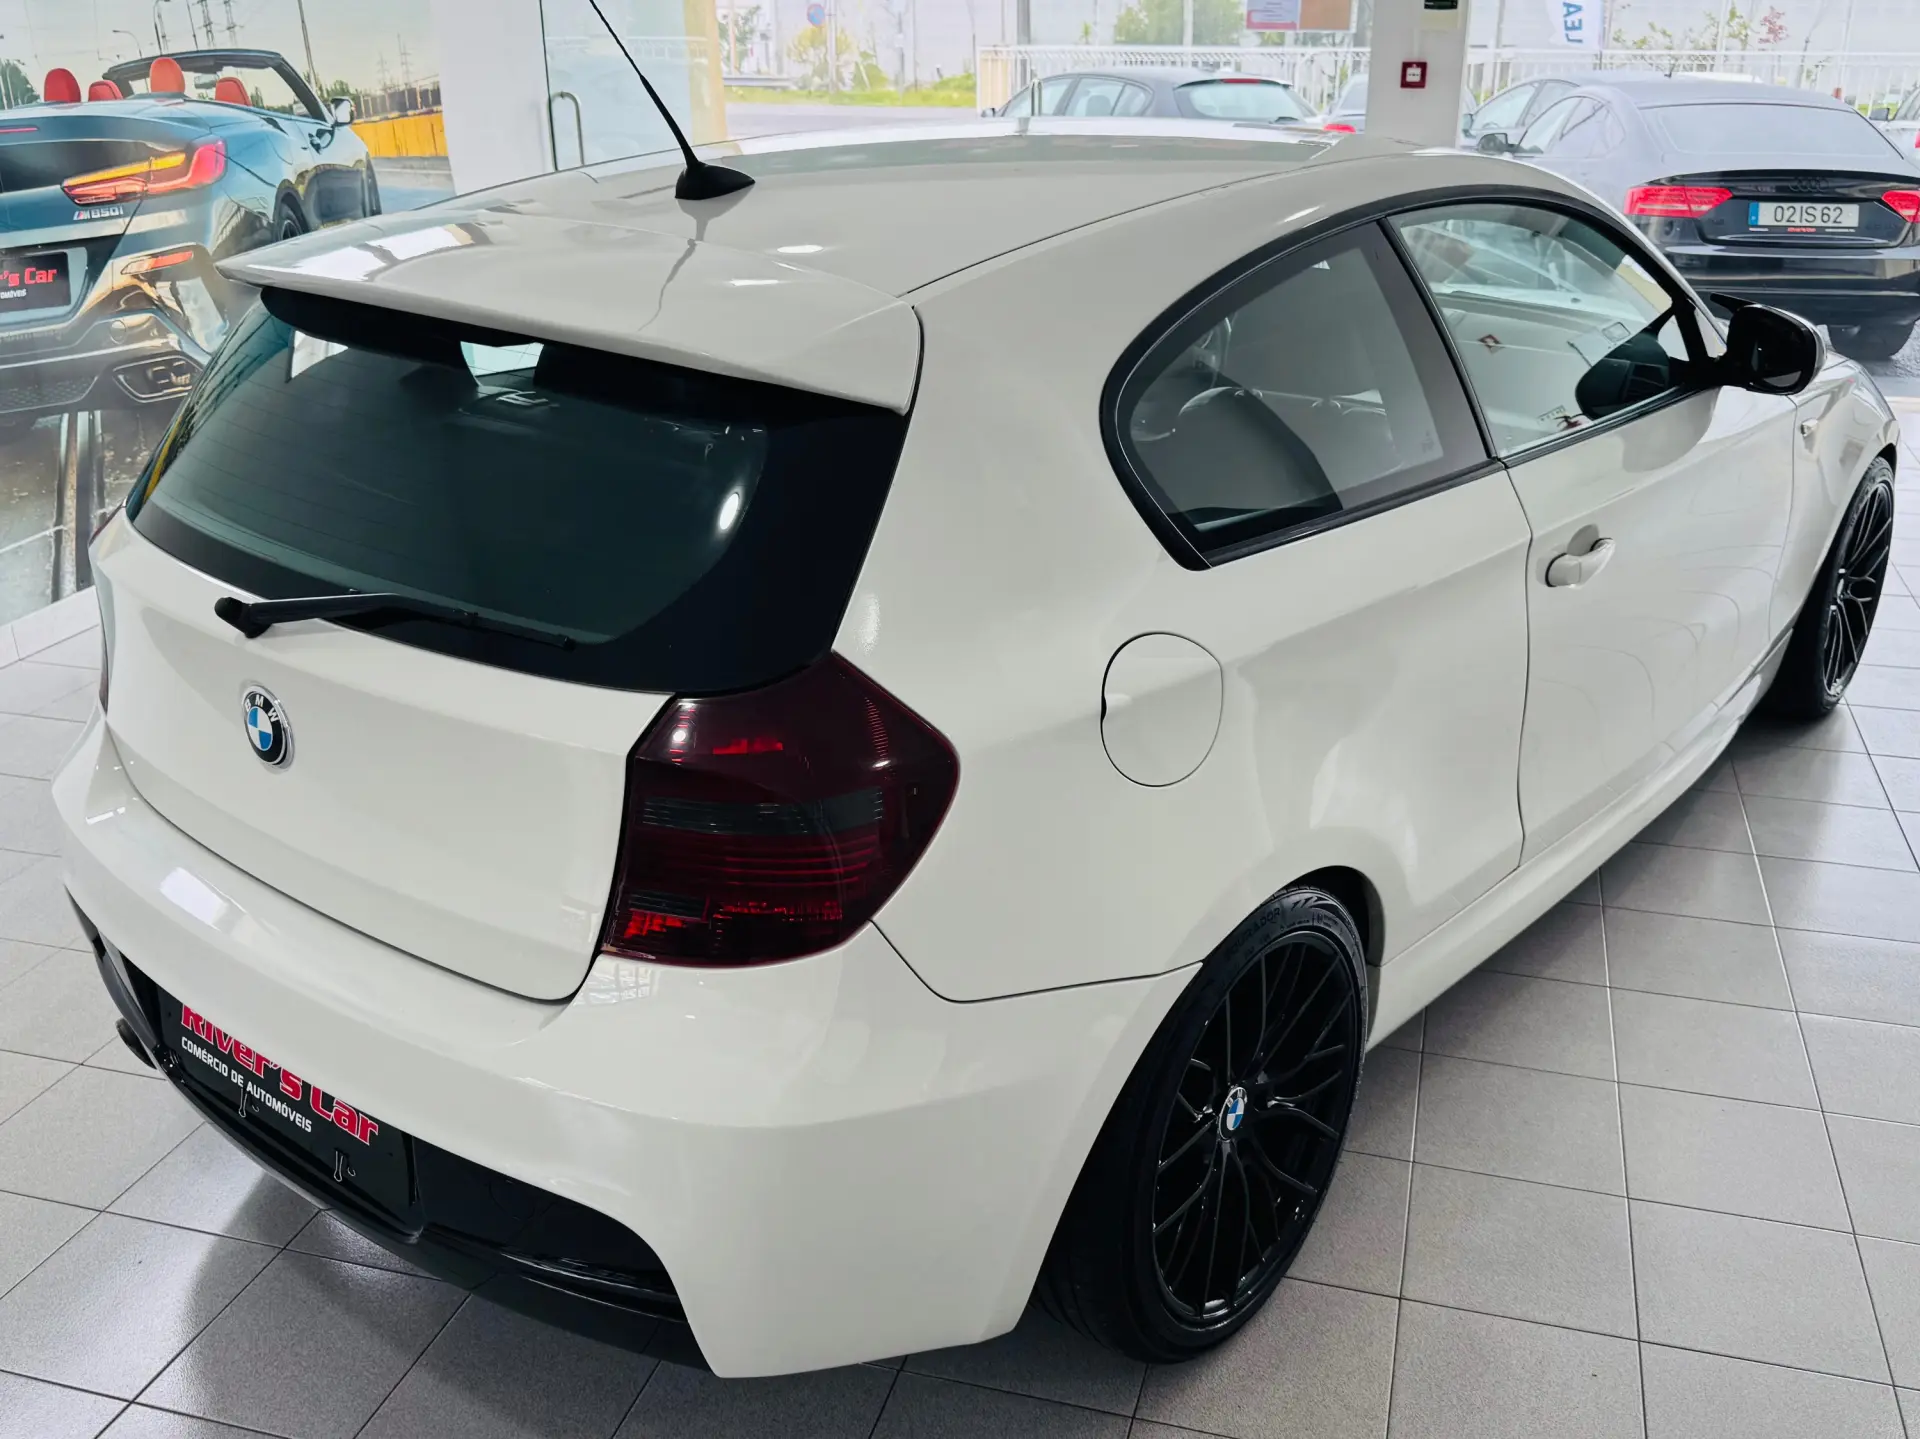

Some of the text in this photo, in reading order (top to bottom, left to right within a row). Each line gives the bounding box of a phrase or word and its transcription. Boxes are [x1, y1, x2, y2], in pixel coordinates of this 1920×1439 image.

[24, 267, 58, 285] Car
[244, 694, 279, 723] BMW
[181, 1035, 313, 1133] COMÉRCIO DE AUTOMÓVEIS
